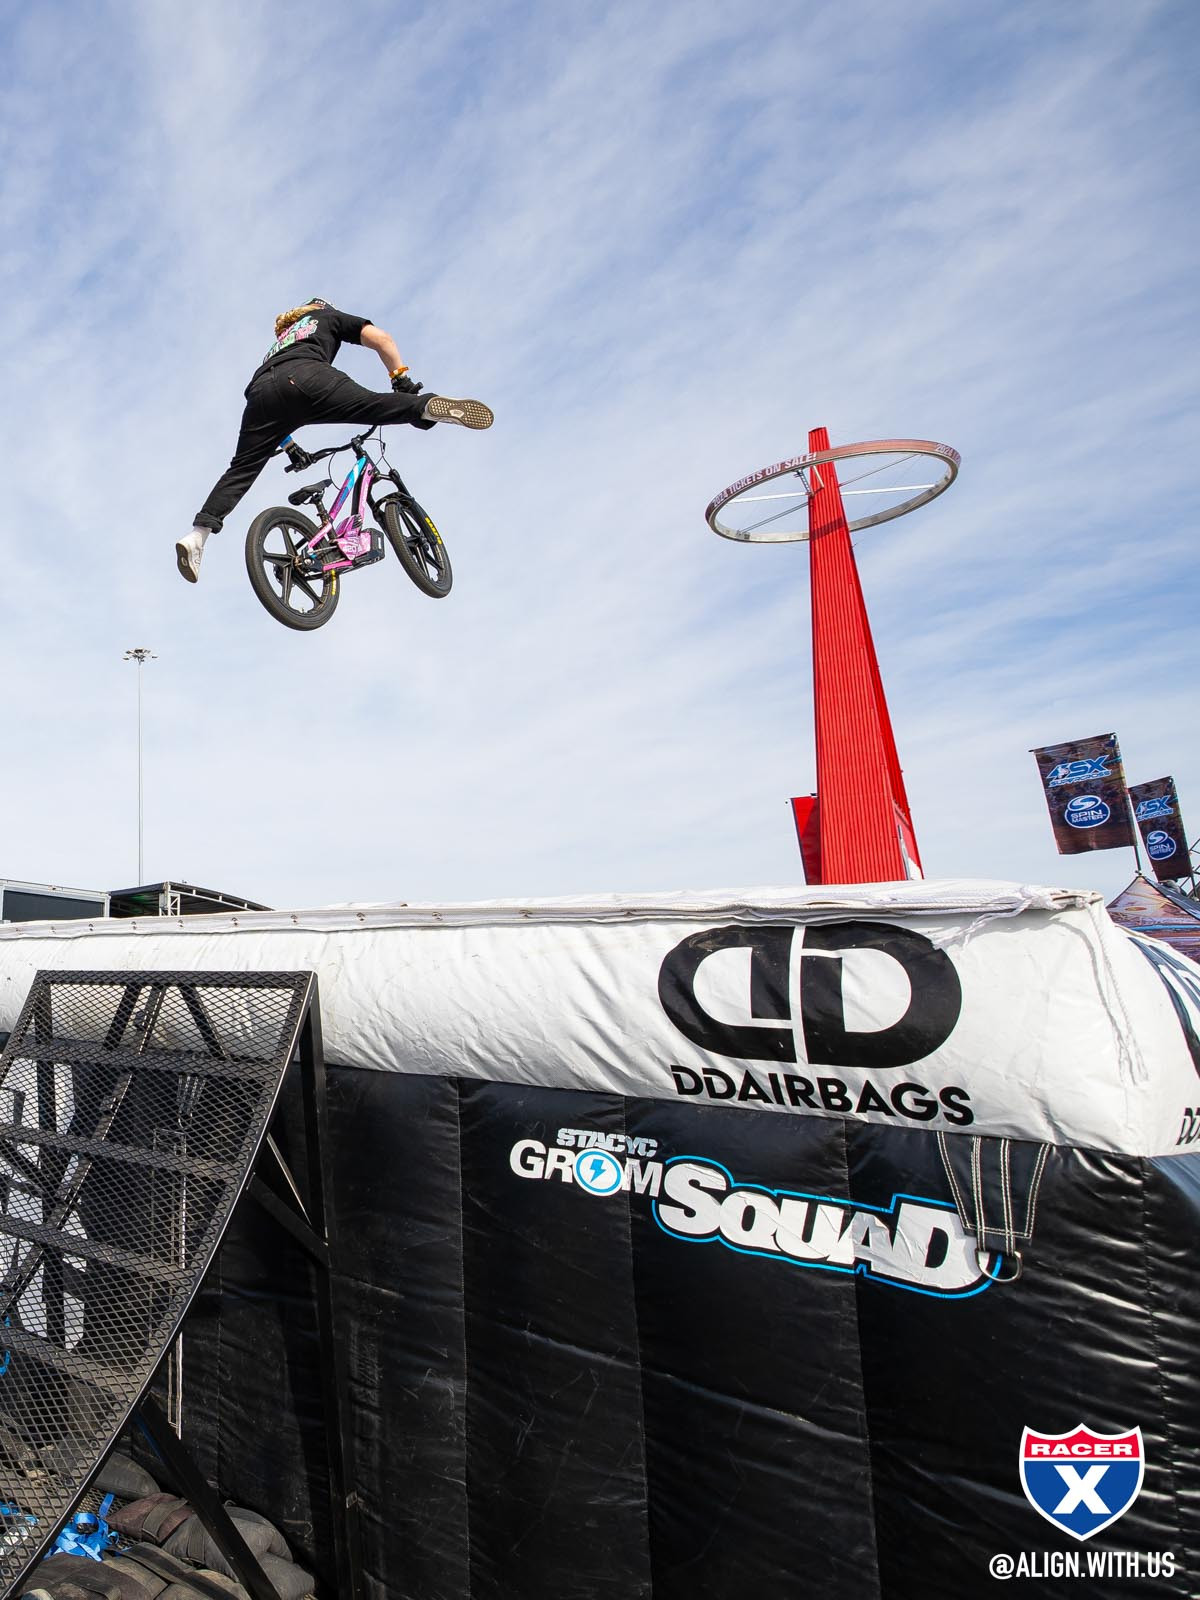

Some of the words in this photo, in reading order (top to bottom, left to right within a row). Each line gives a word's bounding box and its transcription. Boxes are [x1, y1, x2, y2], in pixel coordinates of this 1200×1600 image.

[729, 472, 764, 494] TICKETS
[765, 463, 782, 476] ON
[784, 451, 817, 469] SALE!
[1070, 809, 1102, 818] SPIN
[669, 1064, 975, 1126] DDAIRBAGS
[556, 1127, 659, 1158] STACYC
